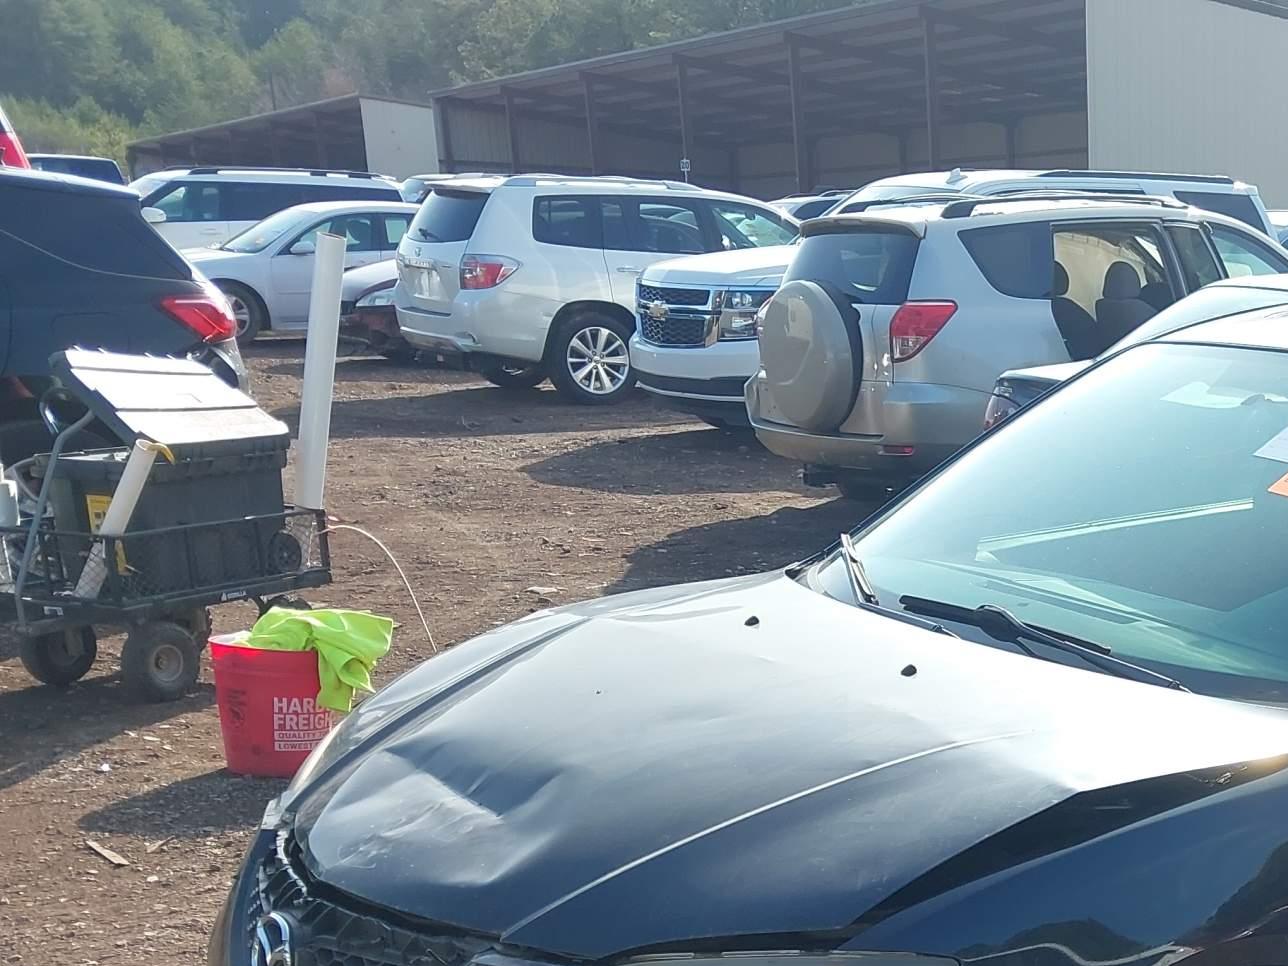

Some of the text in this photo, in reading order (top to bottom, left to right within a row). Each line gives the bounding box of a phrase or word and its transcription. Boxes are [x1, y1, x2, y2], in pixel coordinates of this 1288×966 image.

[273, 697, 329, 713] HAR
[273, 713, 333, 730] FREIGH
[278, 732, 316, 740] QUALITY
[278, 742, 313, 750] LOWEST
